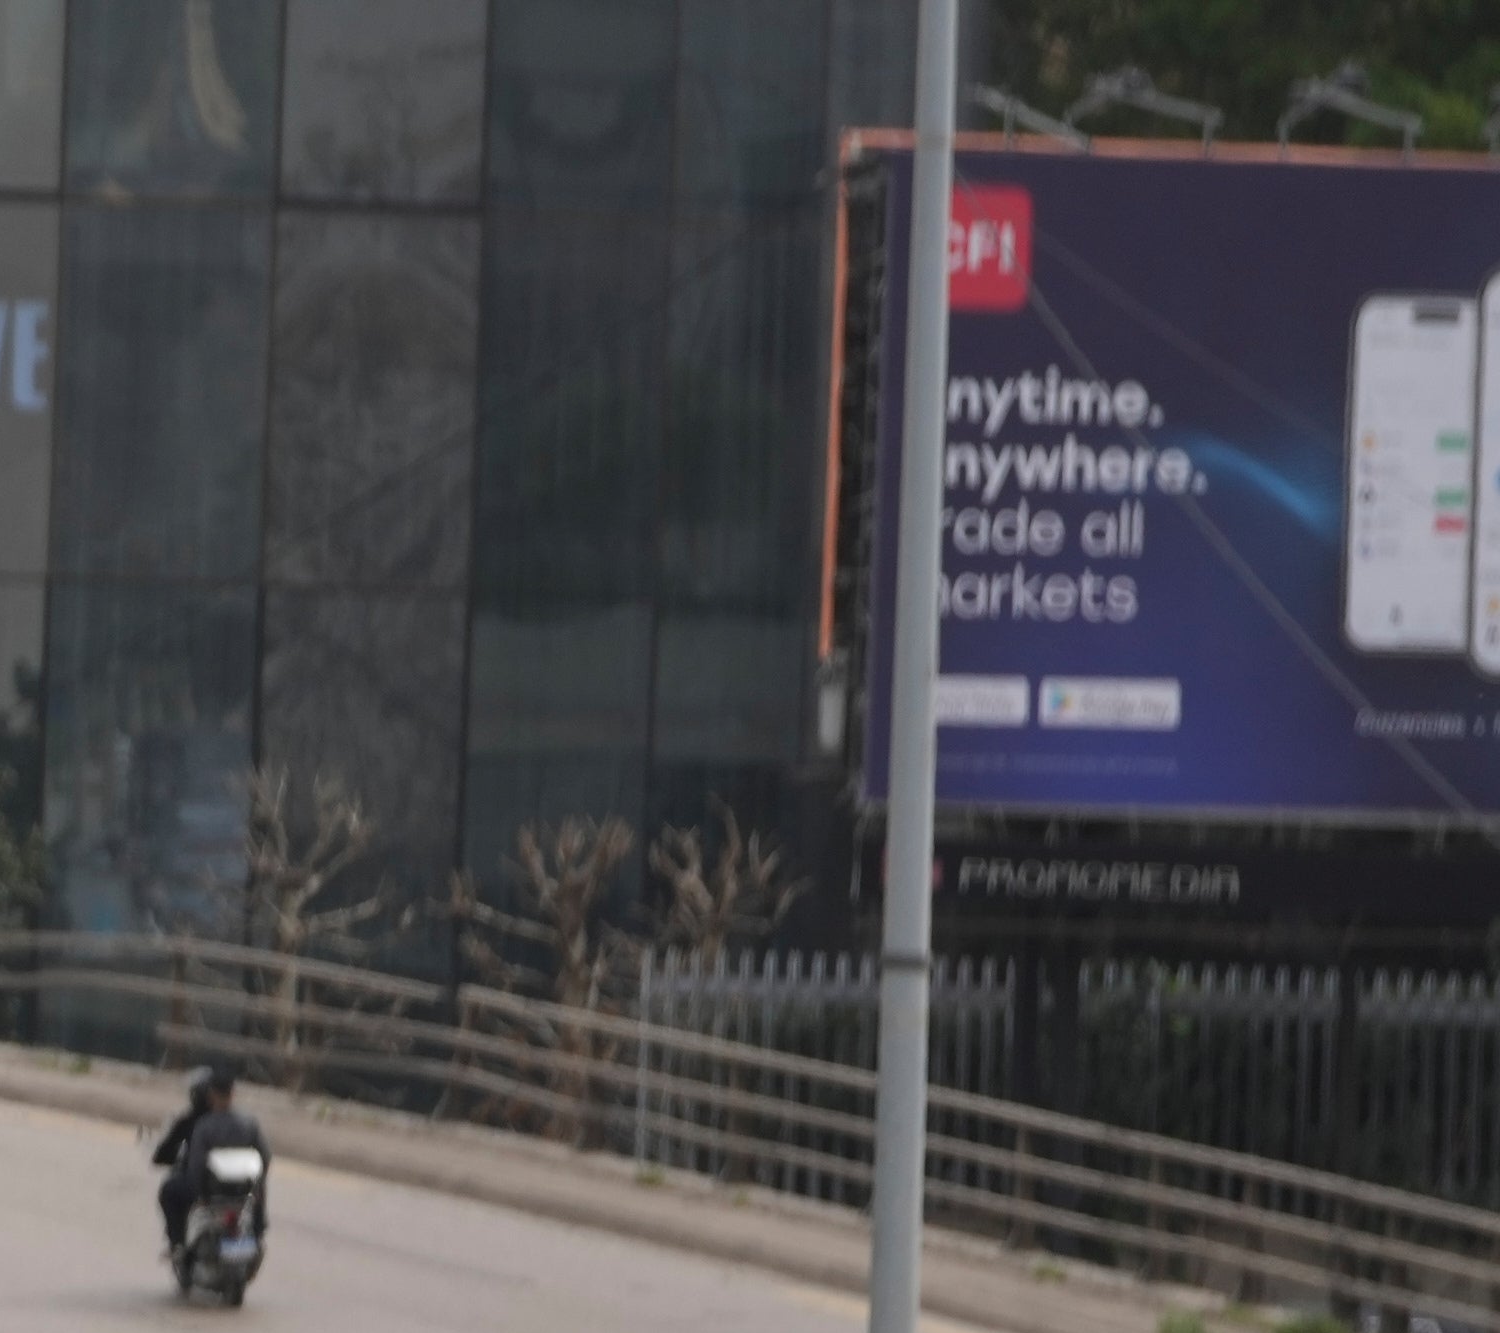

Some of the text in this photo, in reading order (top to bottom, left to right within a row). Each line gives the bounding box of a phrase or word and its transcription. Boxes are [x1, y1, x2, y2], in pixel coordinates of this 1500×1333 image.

[948, 362, 1165, 438] nytime.
[946, 430, 1208, 504] nywhere.
[1080, 496, 1146, 559] all
